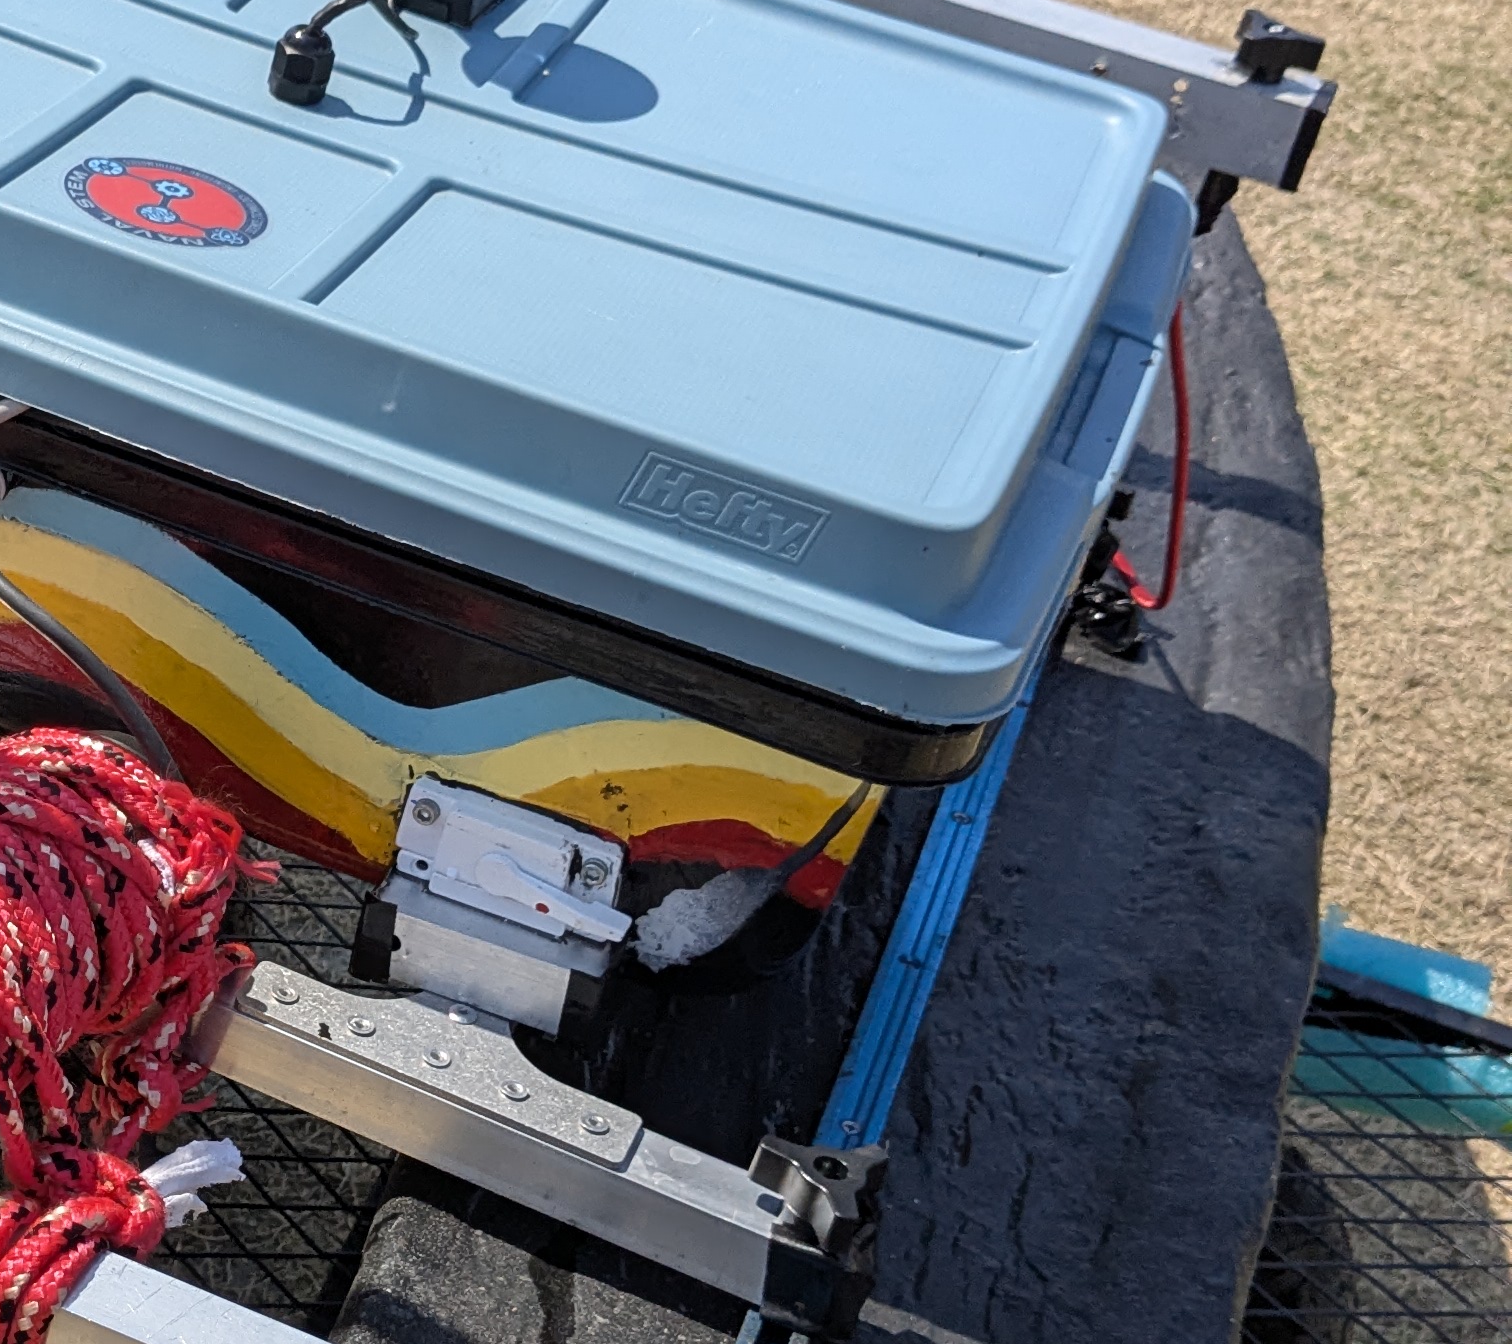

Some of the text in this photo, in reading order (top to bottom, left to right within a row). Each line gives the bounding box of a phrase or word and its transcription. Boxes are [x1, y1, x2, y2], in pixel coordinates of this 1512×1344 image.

[67, 170, 95, 209] STEM
[101, 210, 205, 246] NAVAL
[637, 463, 810, 554] Hefty
